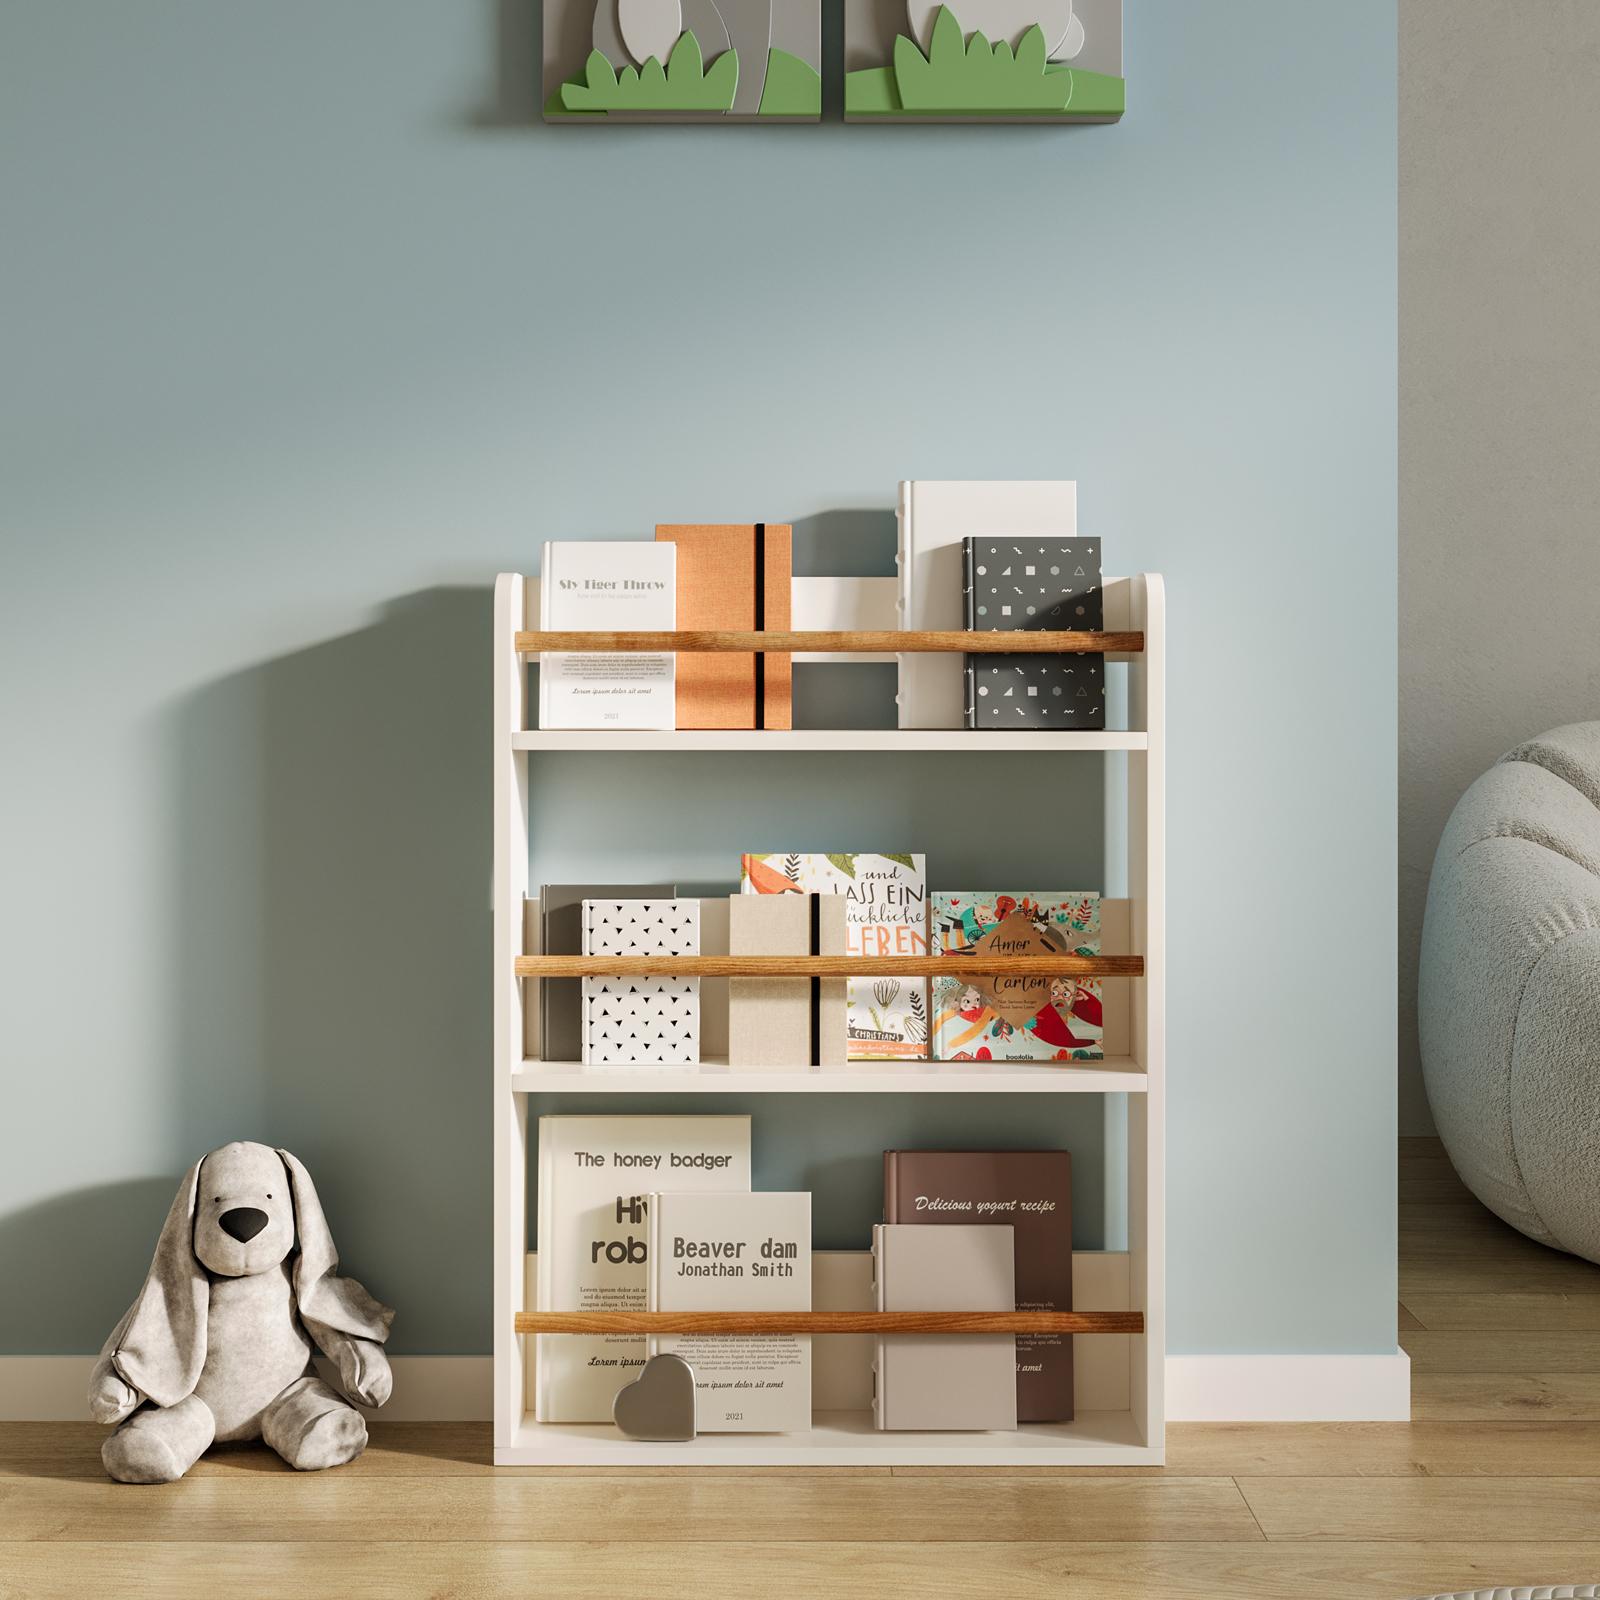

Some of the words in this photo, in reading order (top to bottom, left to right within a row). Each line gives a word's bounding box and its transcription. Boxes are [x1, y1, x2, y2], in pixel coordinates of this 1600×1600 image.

[559, 579, 578, 590] Sly
[584, 579, 617, 590] Tiger
[623, 579, 665, 590] Throw
[862, 866, 902, 880] und
[847, 902, 926, 924] ückliche
[989, 935, 1030, 953] Amor
[574, 1152, 605, 1167] The
[613, 1152, 662, 1170] honey
[670, 1152, 733, 1170] badger
[616, 1196, 648, 1224] Hi
[914, 1196, 973, 1211] Delicious
[976, 1199, 1017, 1215] yogurt
[1020, 1199, 1056, 1214] recipe
[592, 1236, 648, 1264] rob
[673, 1237, 747, 1258] Beaver
[760, 1237, 797, 1258] dam
[677, 1262, 744, 1277] Jonathan
[751, 1262, 793, 1277] Smith
[587, 1356, 618, 1367] Lorem
[695, 1381, 709, 1389] rem
[711, 1381, 733, 1390] ipsum
[734, 1380, 753, 1389] dolor
[754, 1381, 765, 1389] sit
[766, 1381, 784, 1389] amet
[725, 1412, 744, 1421] 2021
